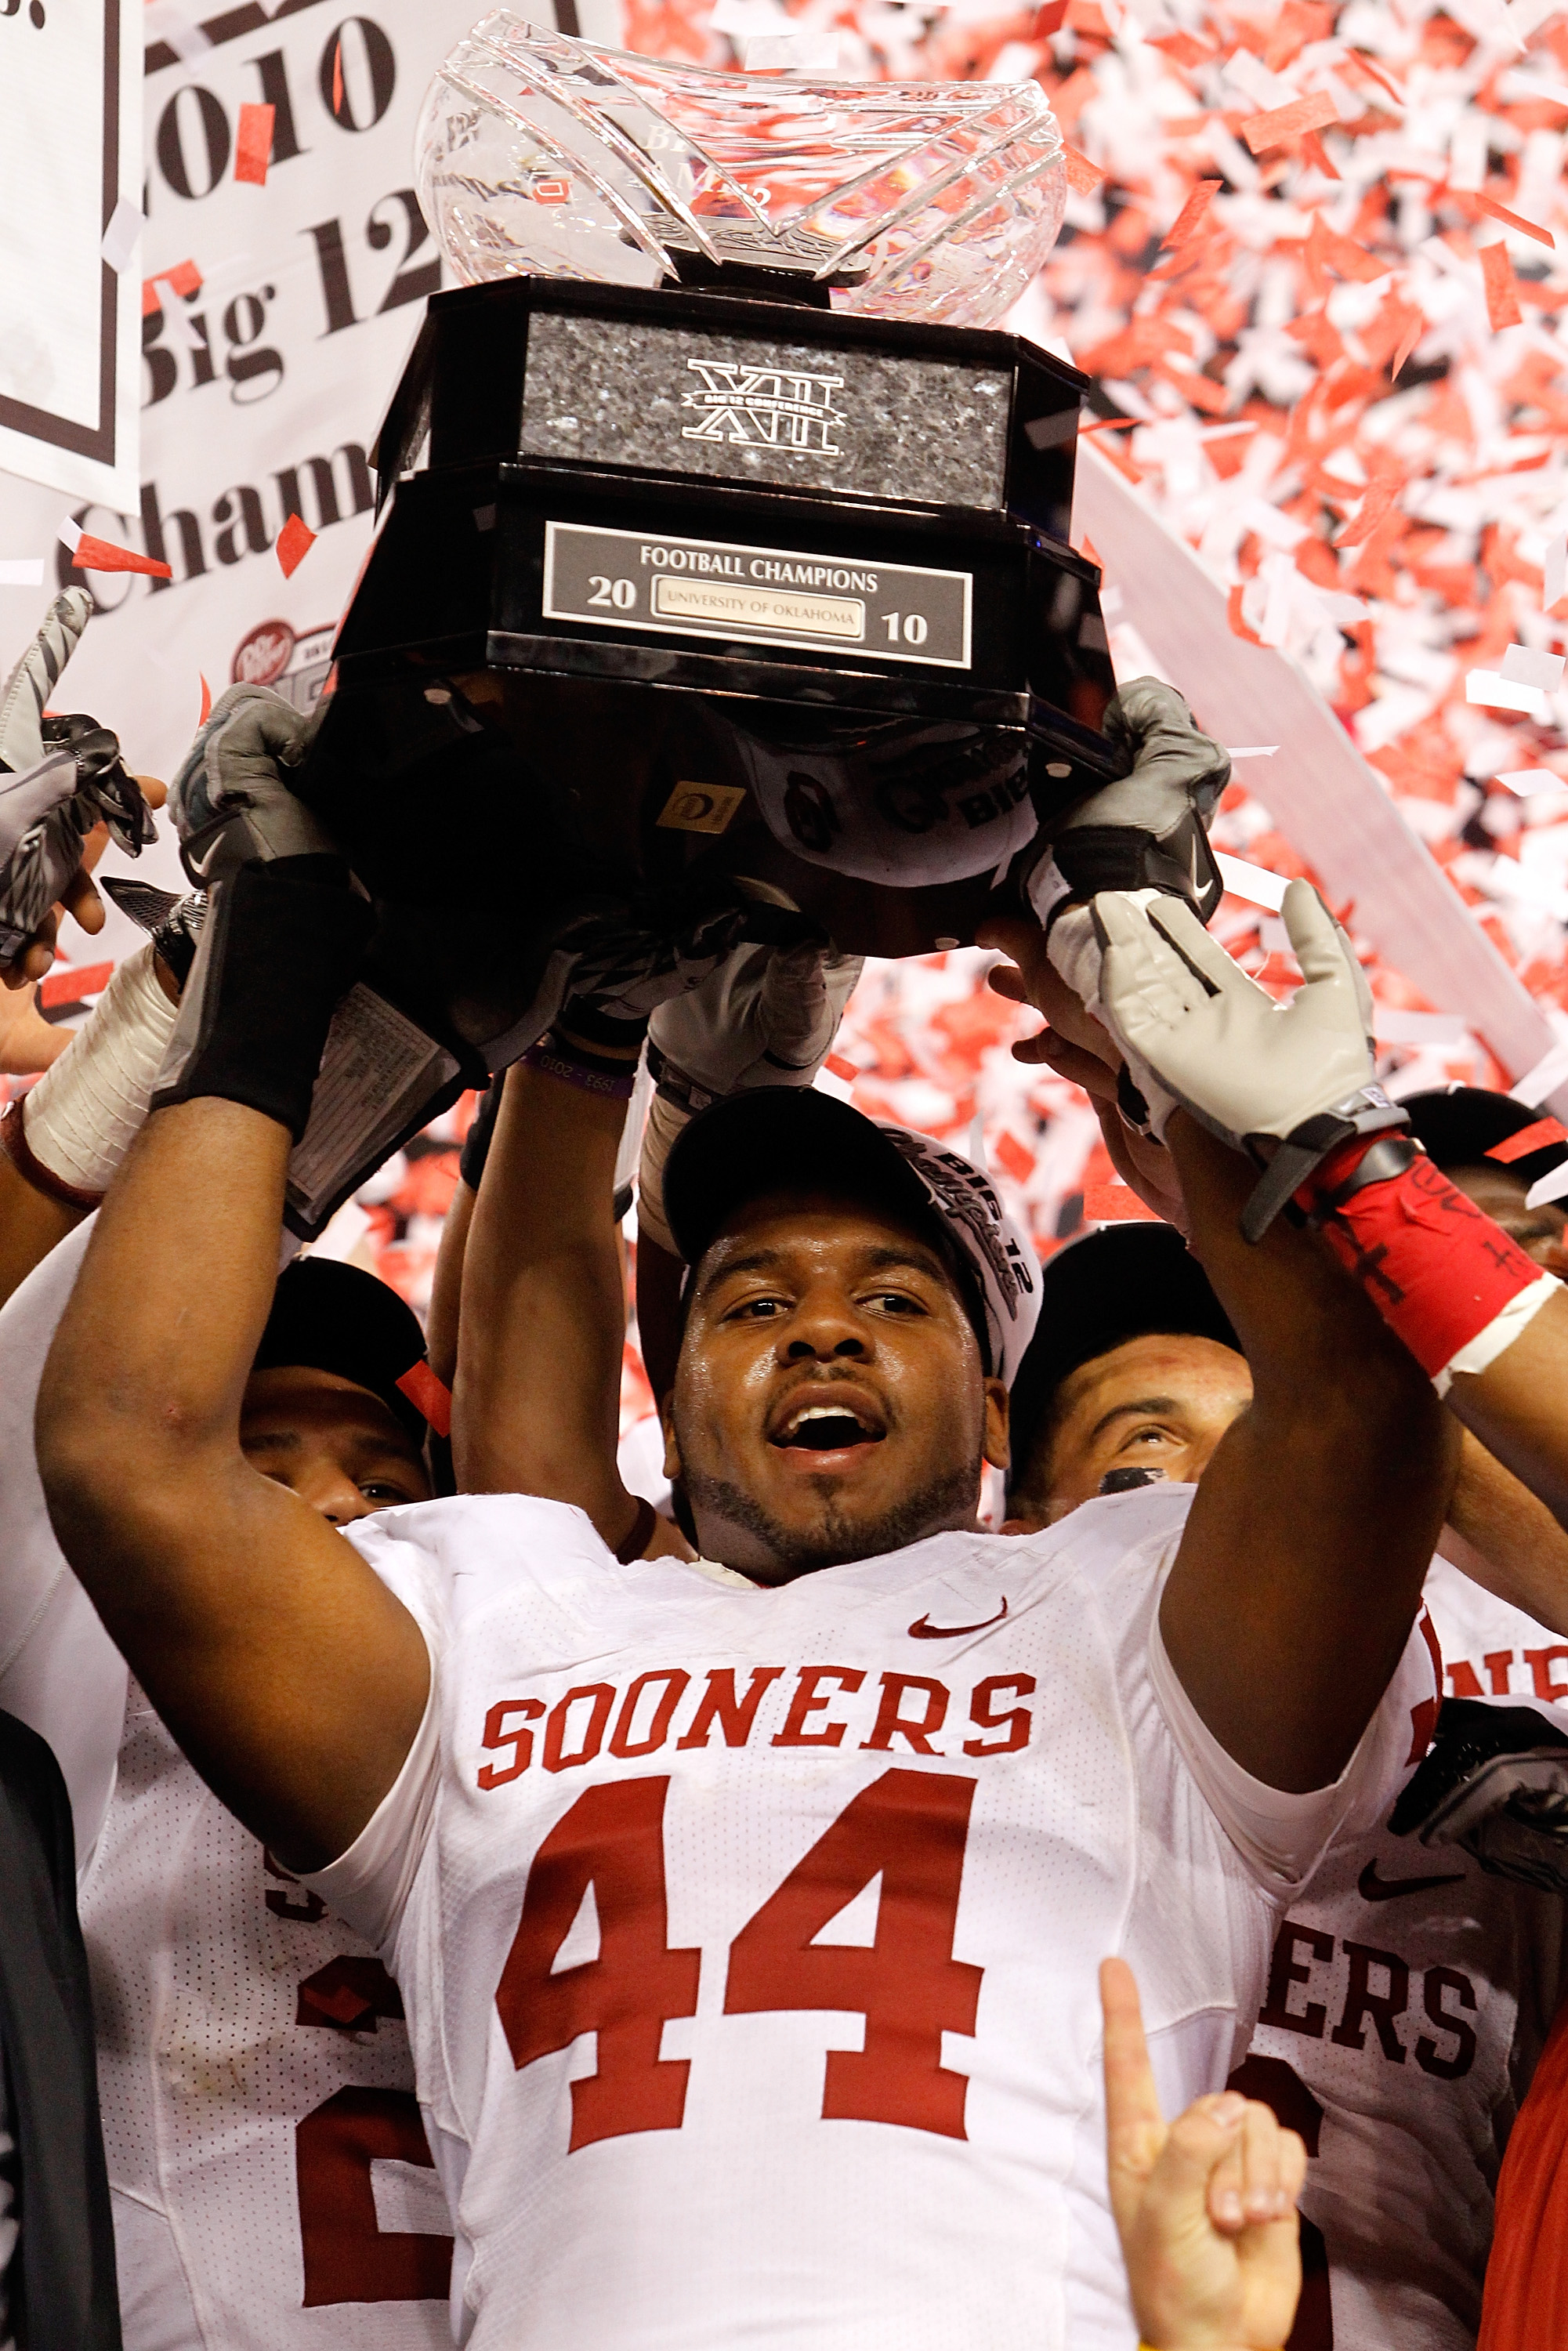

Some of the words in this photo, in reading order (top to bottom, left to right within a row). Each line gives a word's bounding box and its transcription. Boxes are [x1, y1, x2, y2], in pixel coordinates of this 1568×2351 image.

[143, 16, 394, 218] 010
[299, 187, 442, 339] 12
[704, 394, 727, 404] BIG
[729, 395, 744, 406] 12
[745, 397, 824, 418] CONFERENCE
[587, 574, 636, 610] 20
[640, 545, 745, 578] FOOTBALL
[749, 558, 878, 593] CHAMPIONS
[668, 589, 747, 610] UNIVERSITY
[750, 600, 769, 613] OF
[773, 603, 855, 625] OKLAHOMA
[881, 611, 928, 644] 10
[933, 1152, 1003, 1220] BIG
[1005, 1238, 1034, 1294] 12
[476, 1665, 1037, 1791] SOONERS
[494, 1767, 985, 2154] 44
[1259, 1920, 1478, 2081] ERS
